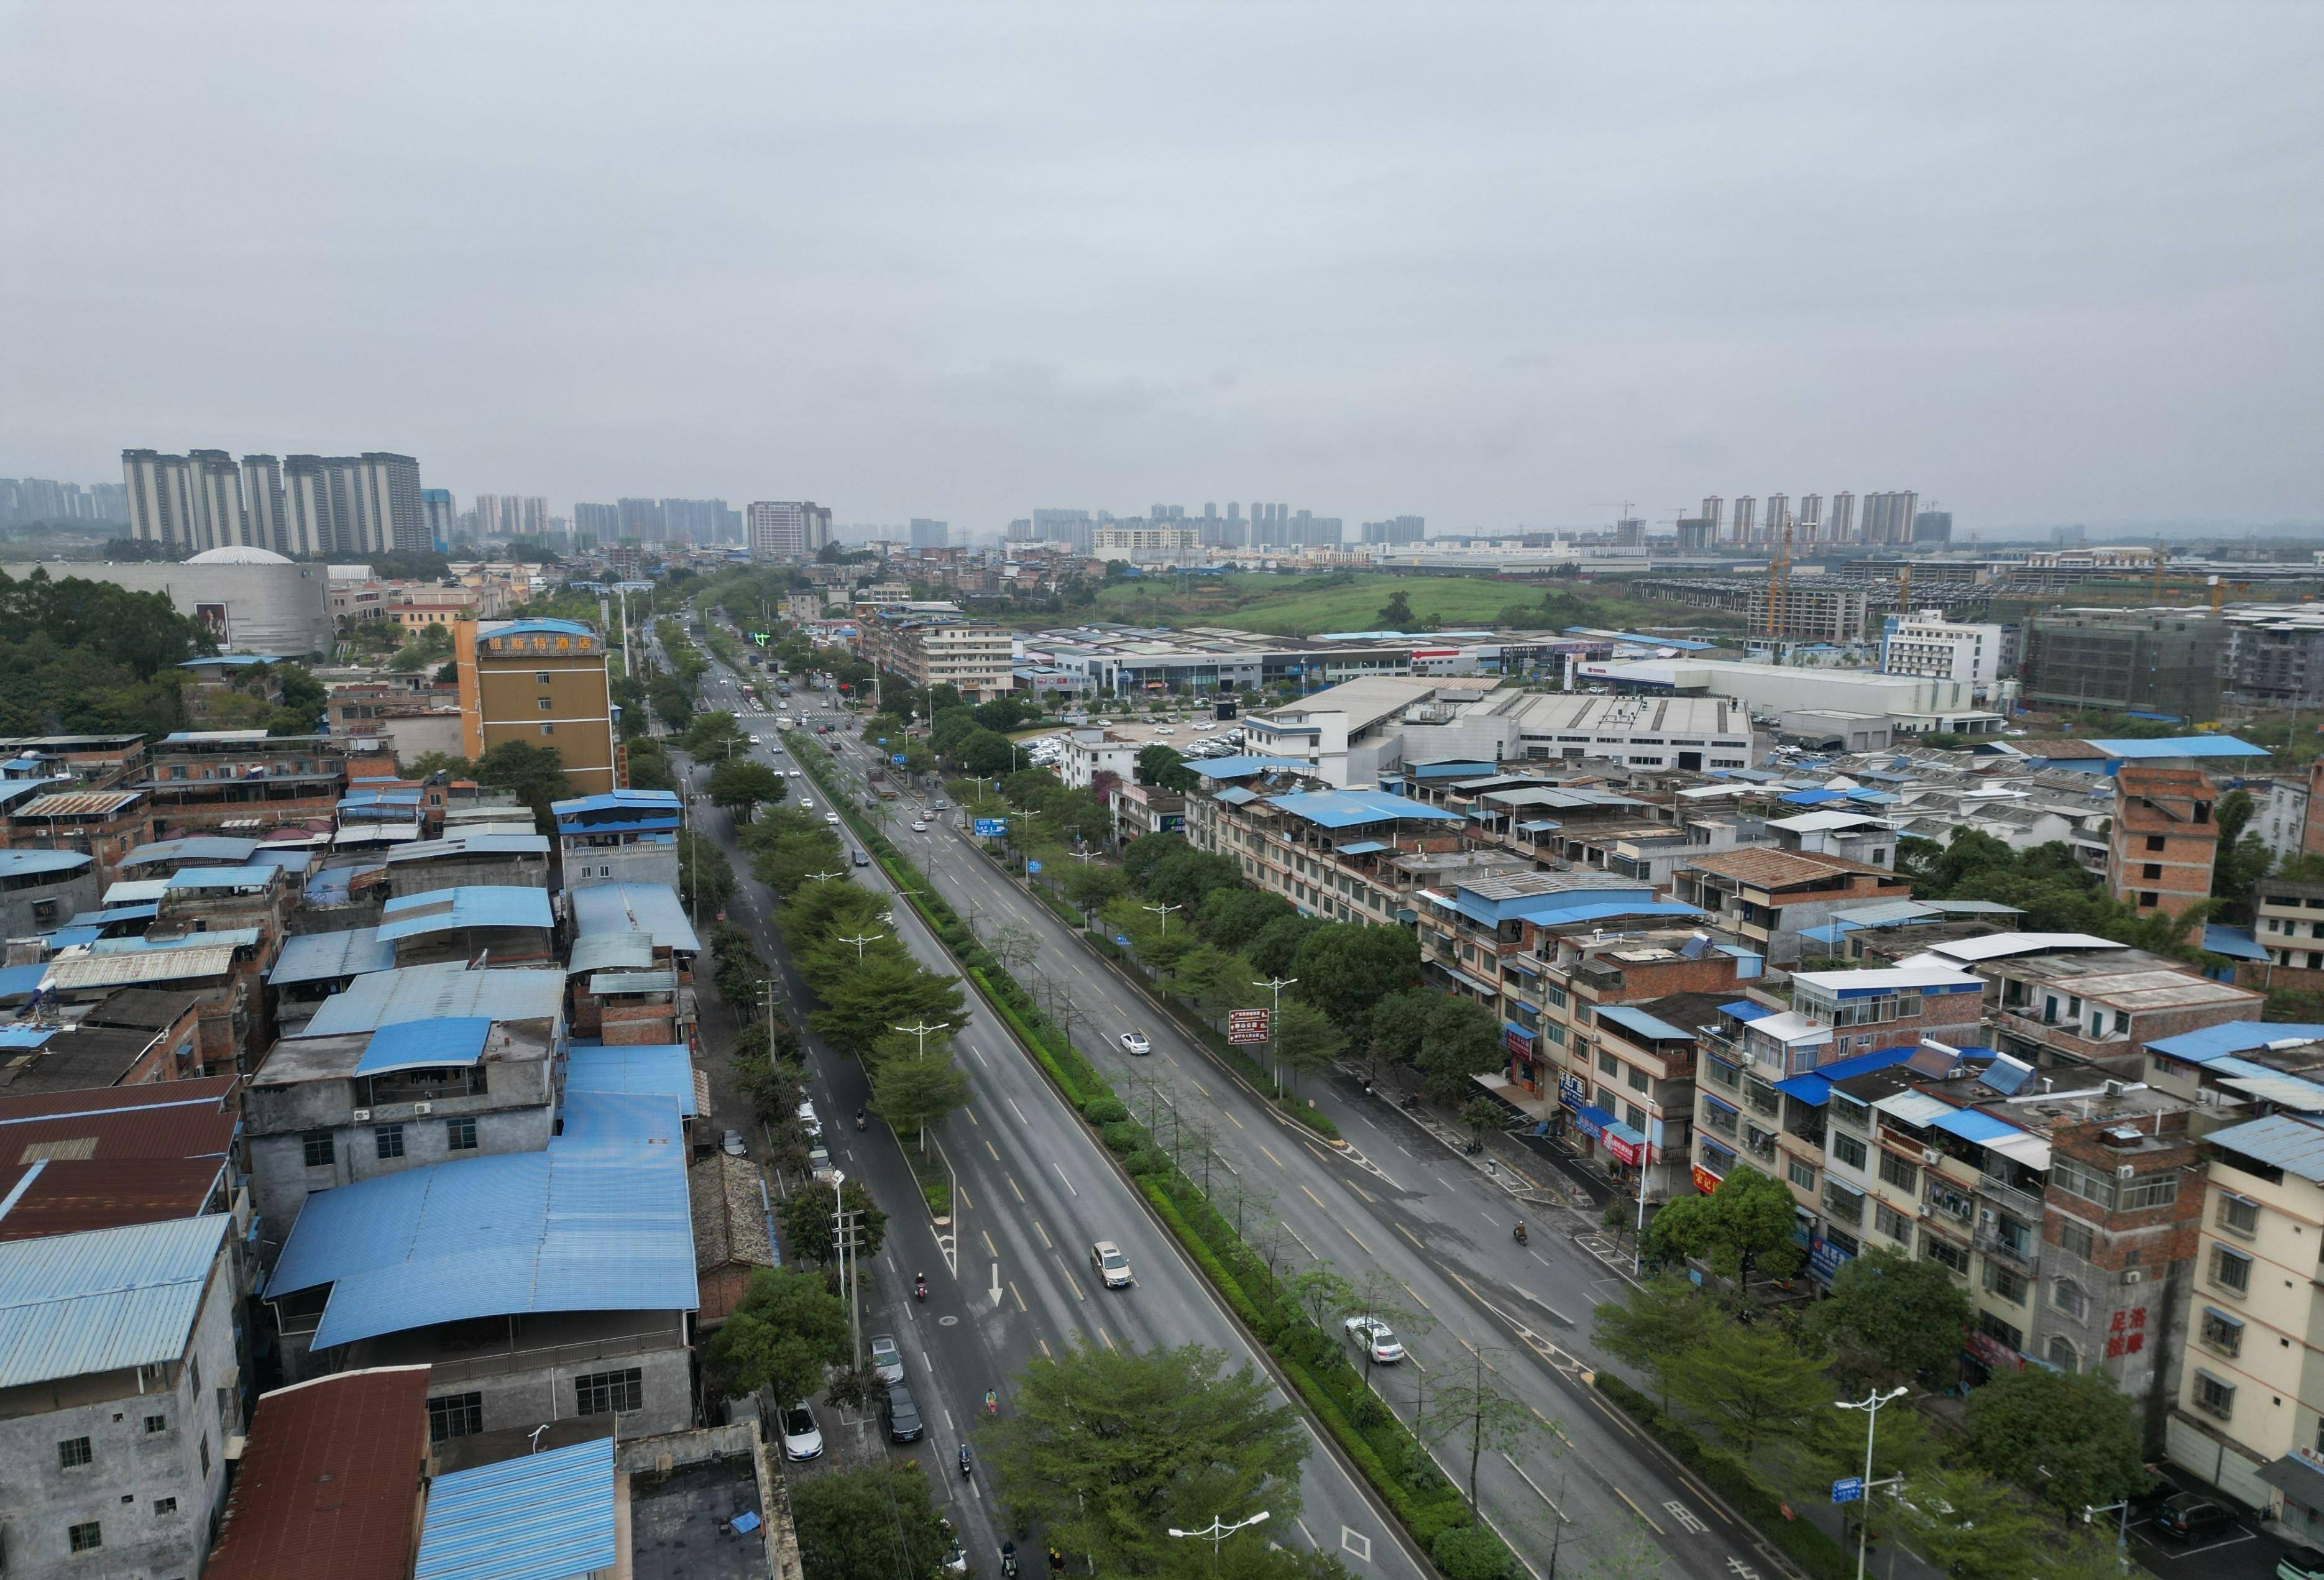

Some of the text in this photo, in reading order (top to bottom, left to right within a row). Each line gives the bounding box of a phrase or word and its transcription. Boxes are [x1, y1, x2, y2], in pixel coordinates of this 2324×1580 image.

[489, 636, 592, 650] 雅斯特酒店
[2109, 1307, 2148, 1333] 足浴
[2106, 1332, 2145, 1359] 按摩
[1662, 1500, 1711, 1535] 用
